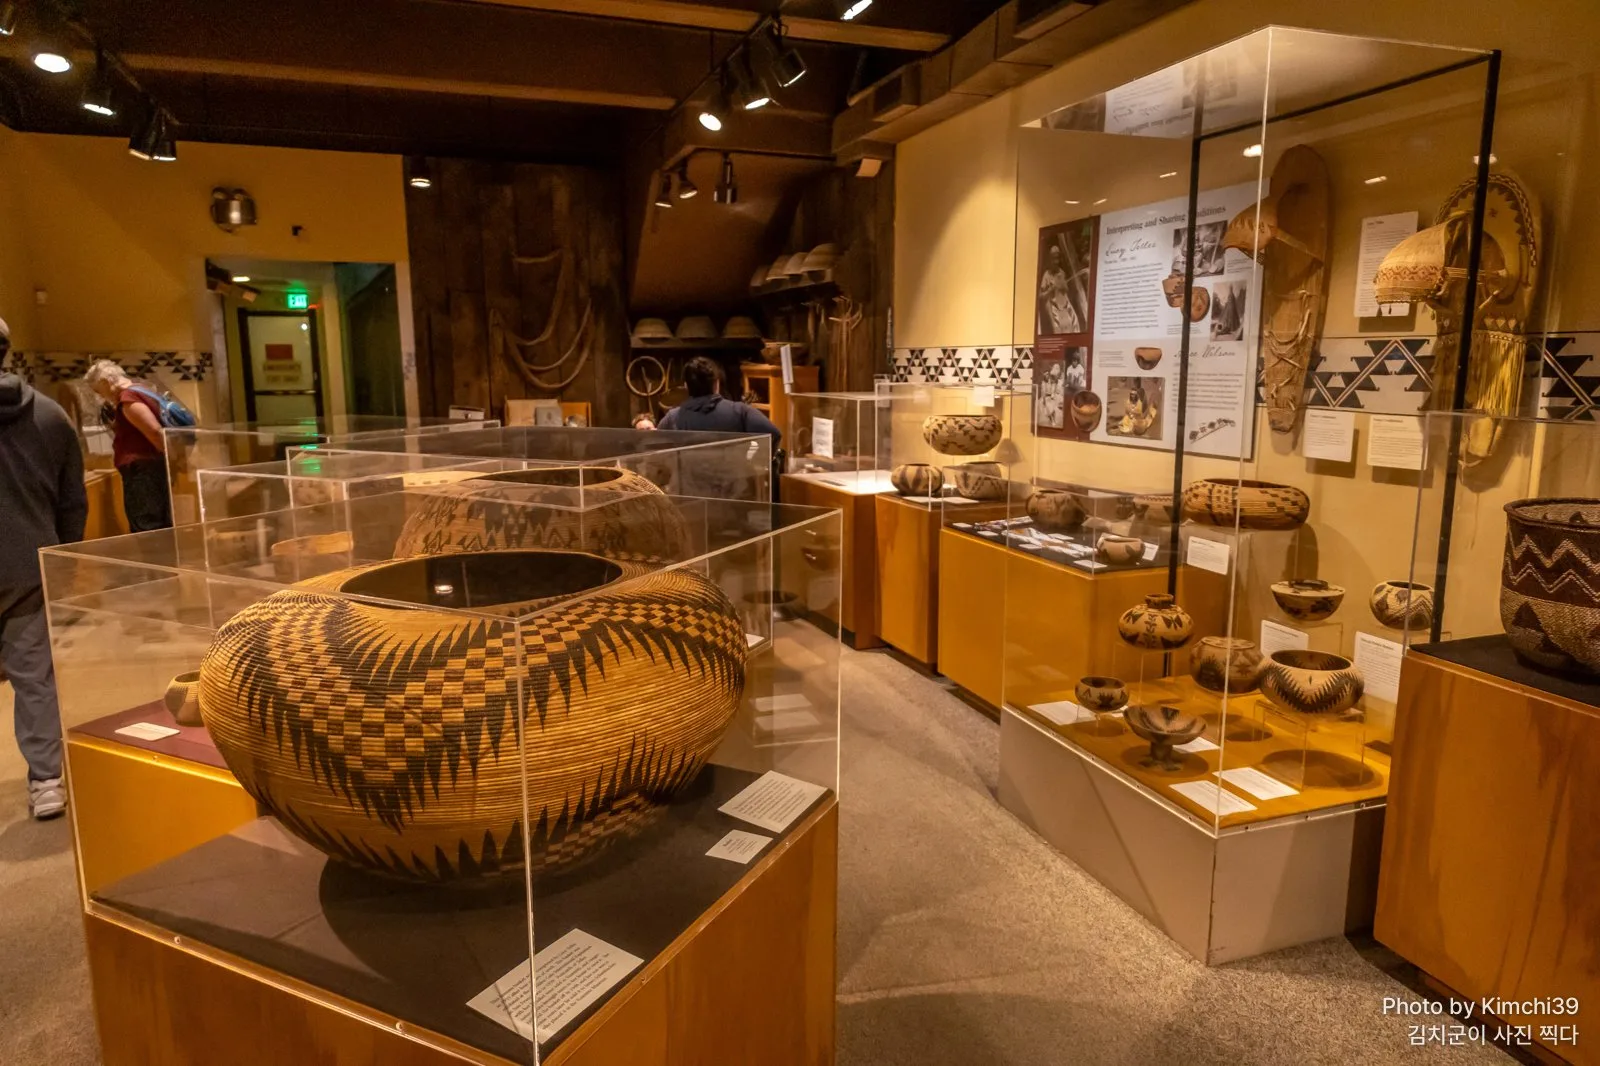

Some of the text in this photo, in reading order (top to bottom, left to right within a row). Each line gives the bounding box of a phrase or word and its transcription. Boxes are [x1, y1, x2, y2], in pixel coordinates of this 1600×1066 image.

[1106, 222, 1143, 236] Interpreting
[1144, 217, 1157, 228] and
[1158, 213, 1186, 225] Sharing
